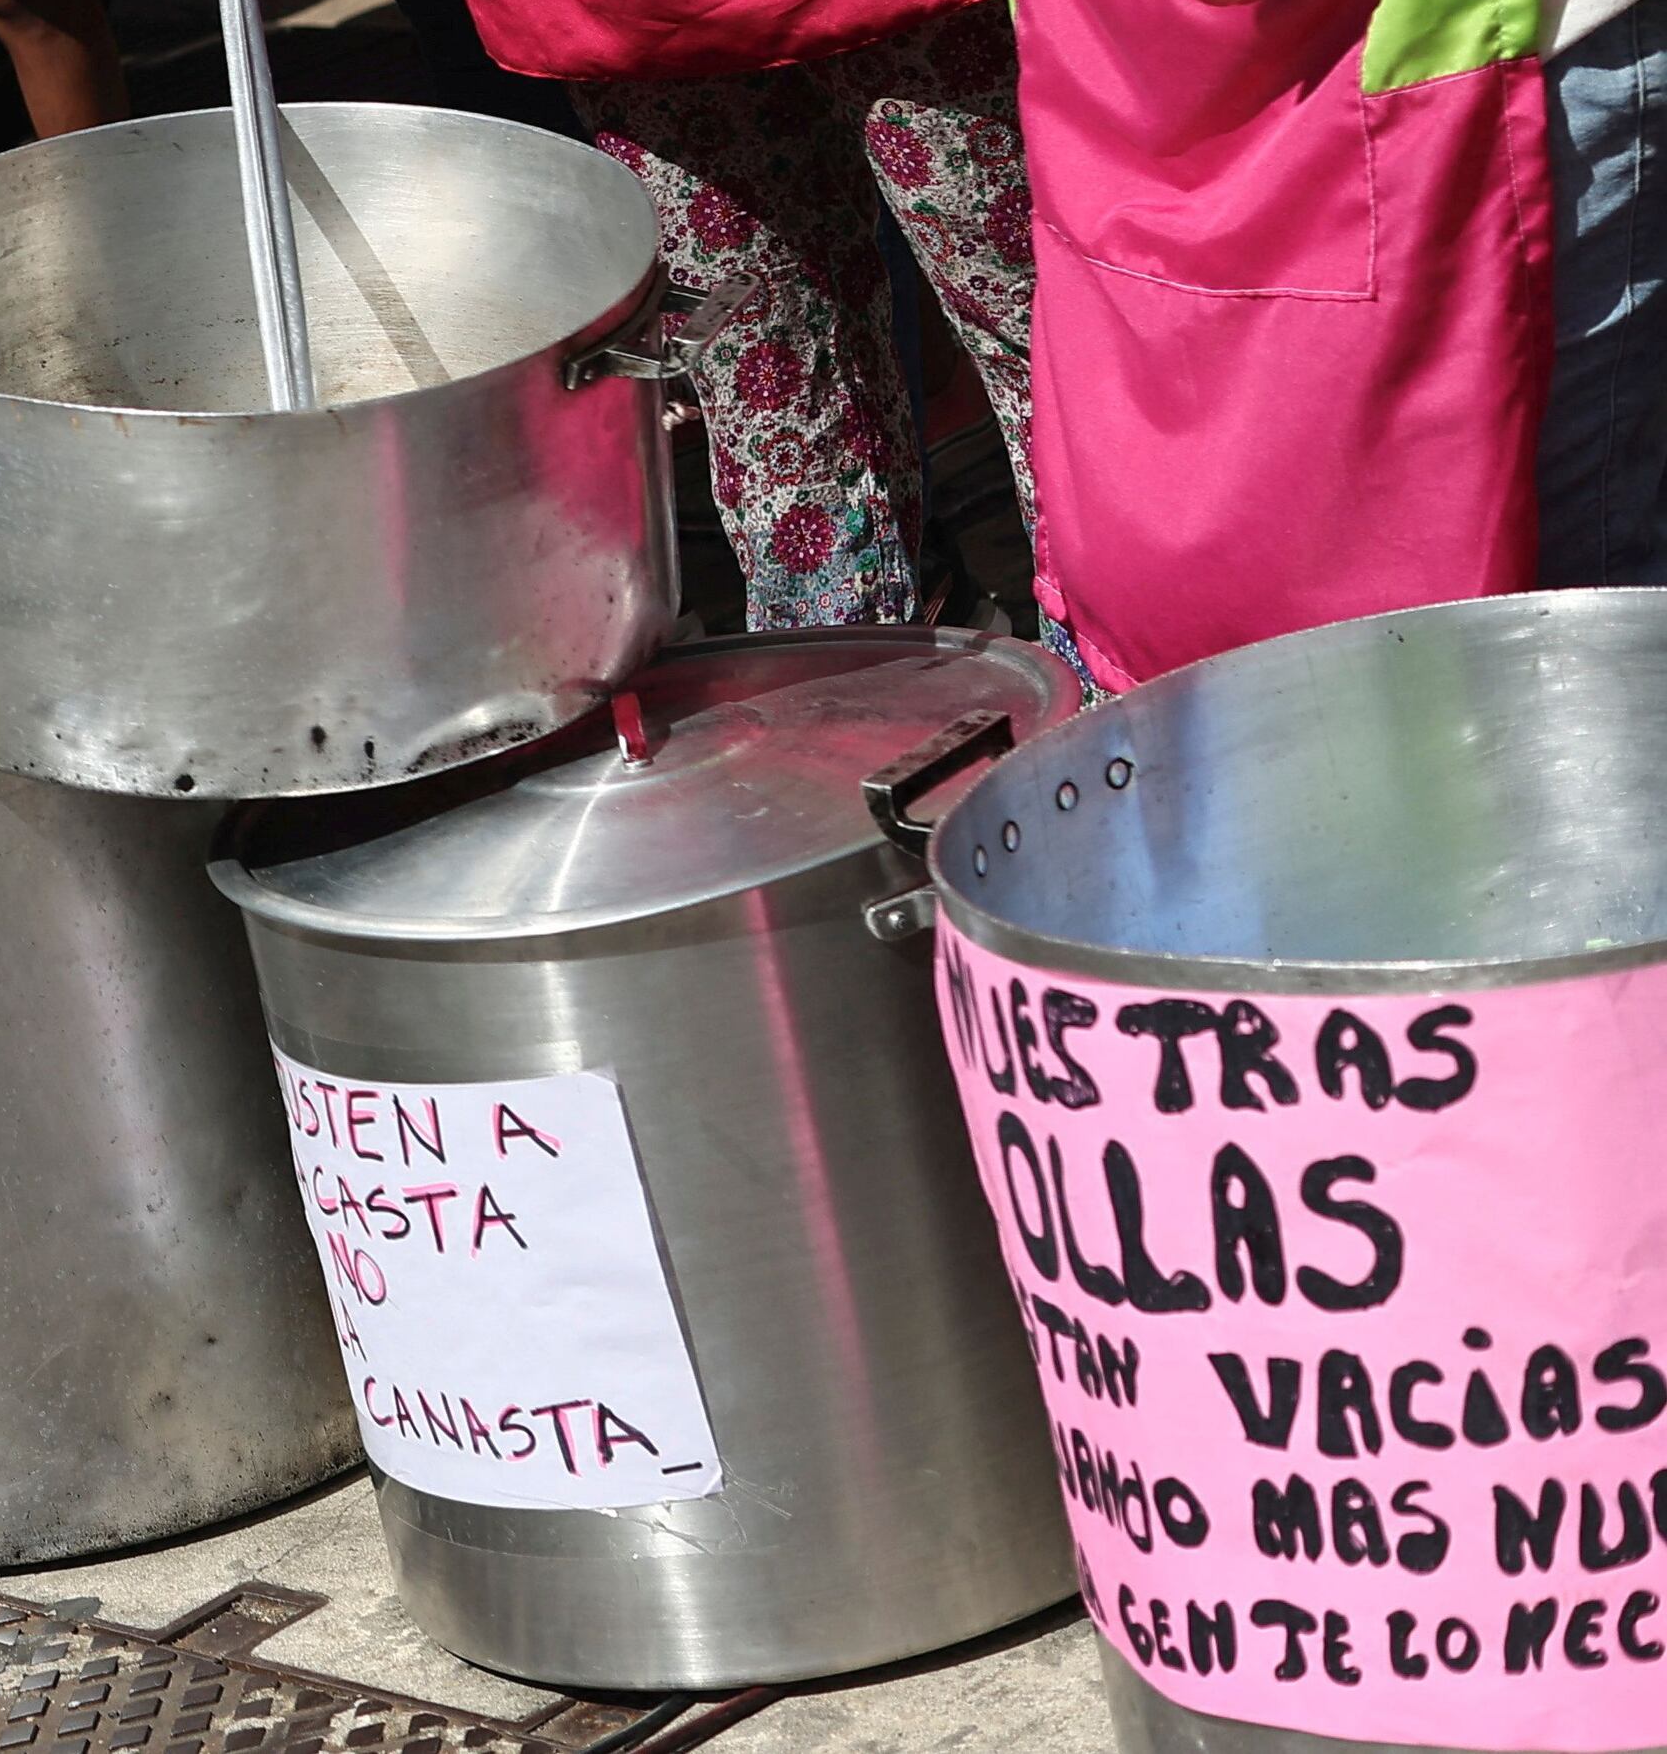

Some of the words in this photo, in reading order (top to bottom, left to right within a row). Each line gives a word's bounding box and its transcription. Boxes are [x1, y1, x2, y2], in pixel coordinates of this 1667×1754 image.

[492, 1101, 562, 1159] A
[312, 1165, 529, 1259] CASTA
[995, 1109, 1405, 1314] OLLAS
[325, 1229, 387, 1307] NO
[1251, 1472, 1451, 1575] MAS
